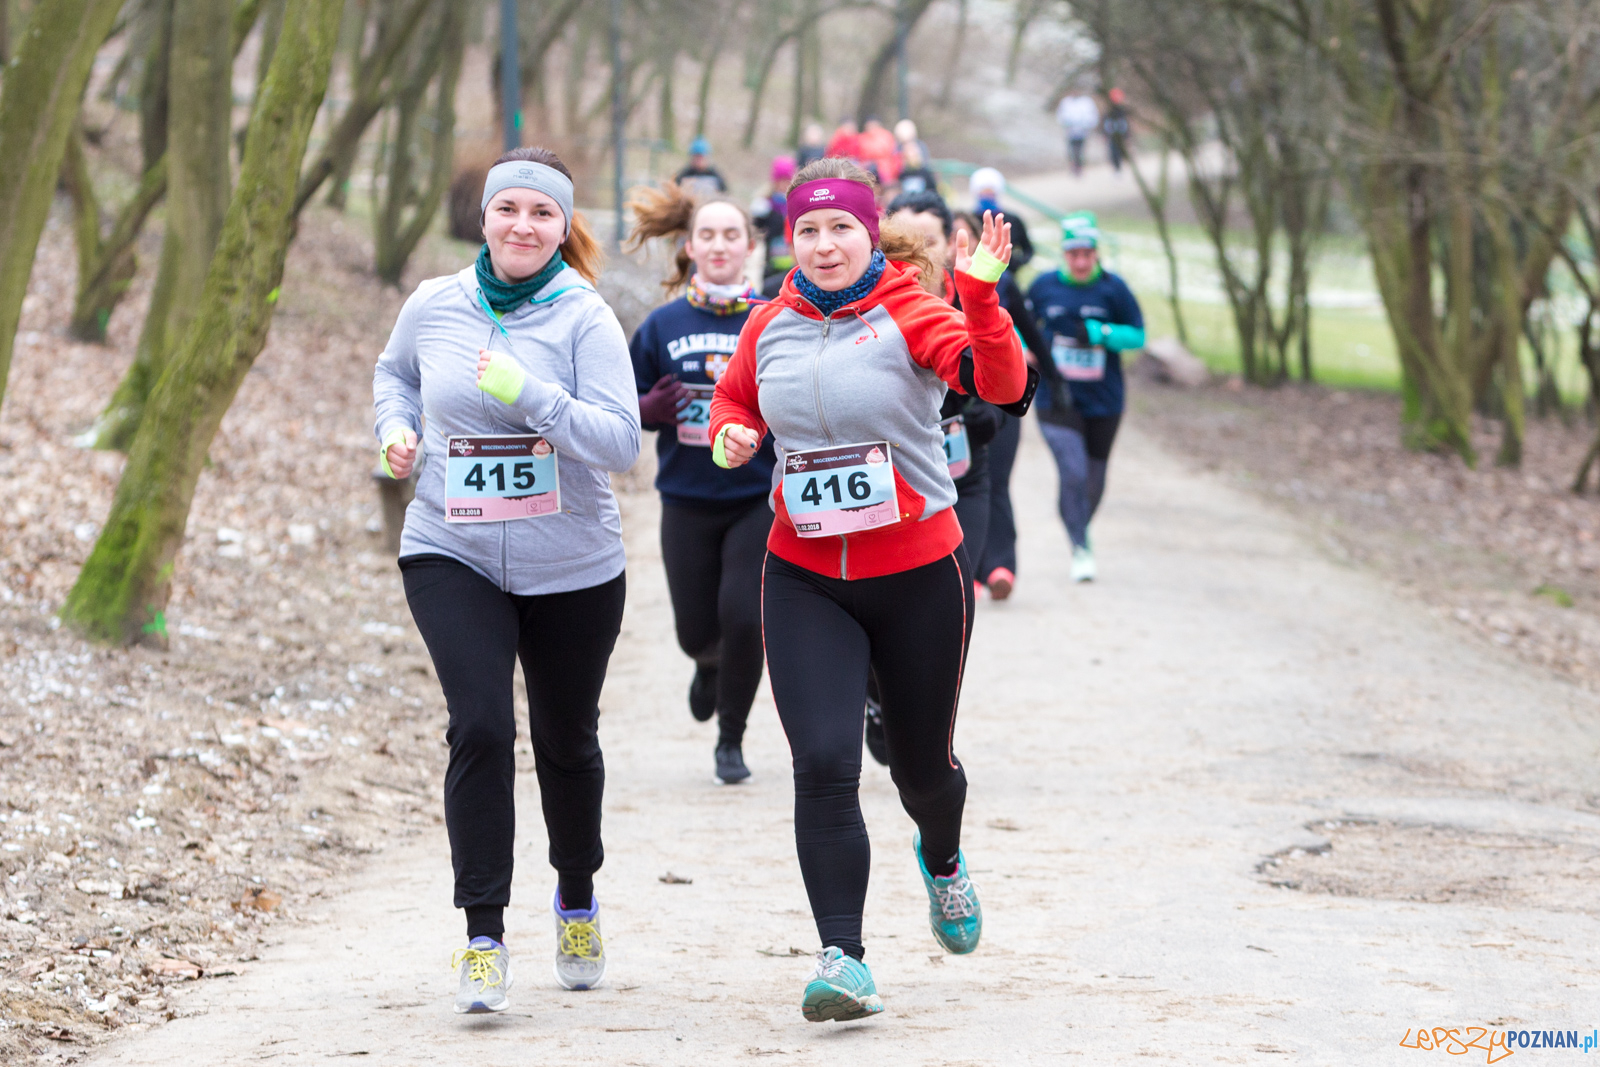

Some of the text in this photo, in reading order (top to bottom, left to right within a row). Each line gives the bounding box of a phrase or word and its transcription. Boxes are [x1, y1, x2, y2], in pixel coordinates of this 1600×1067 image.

[667, 332, 740, 360] CAMBRI
[464, 462, 535, 491] 415
[801, 471, 871, 506] 416
[452, 508, 481, 516] 11.02.2018
